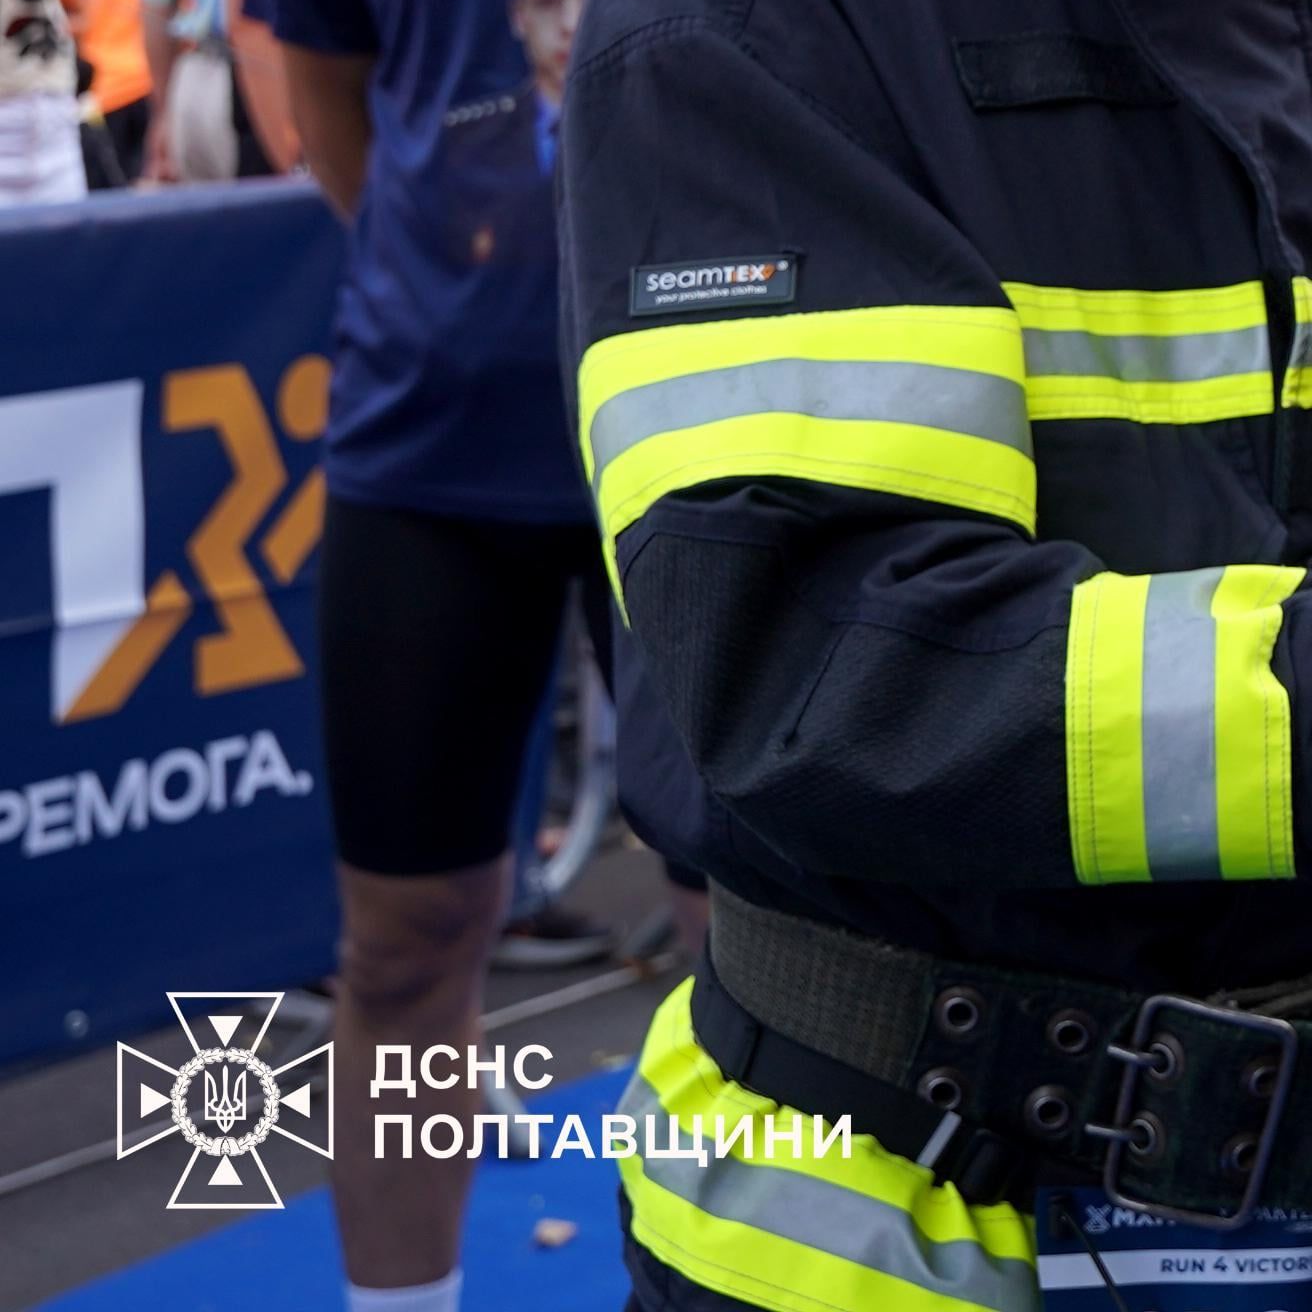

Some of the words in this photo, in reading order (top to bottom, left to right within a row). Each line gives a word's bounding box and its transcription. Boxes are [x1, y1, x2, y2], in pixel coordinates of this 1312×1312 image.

[678, 286, 730, 303] protective
[1160, 1257, 1206, 1275] RUN
[1212, 1255, 1230, 1272] 4
